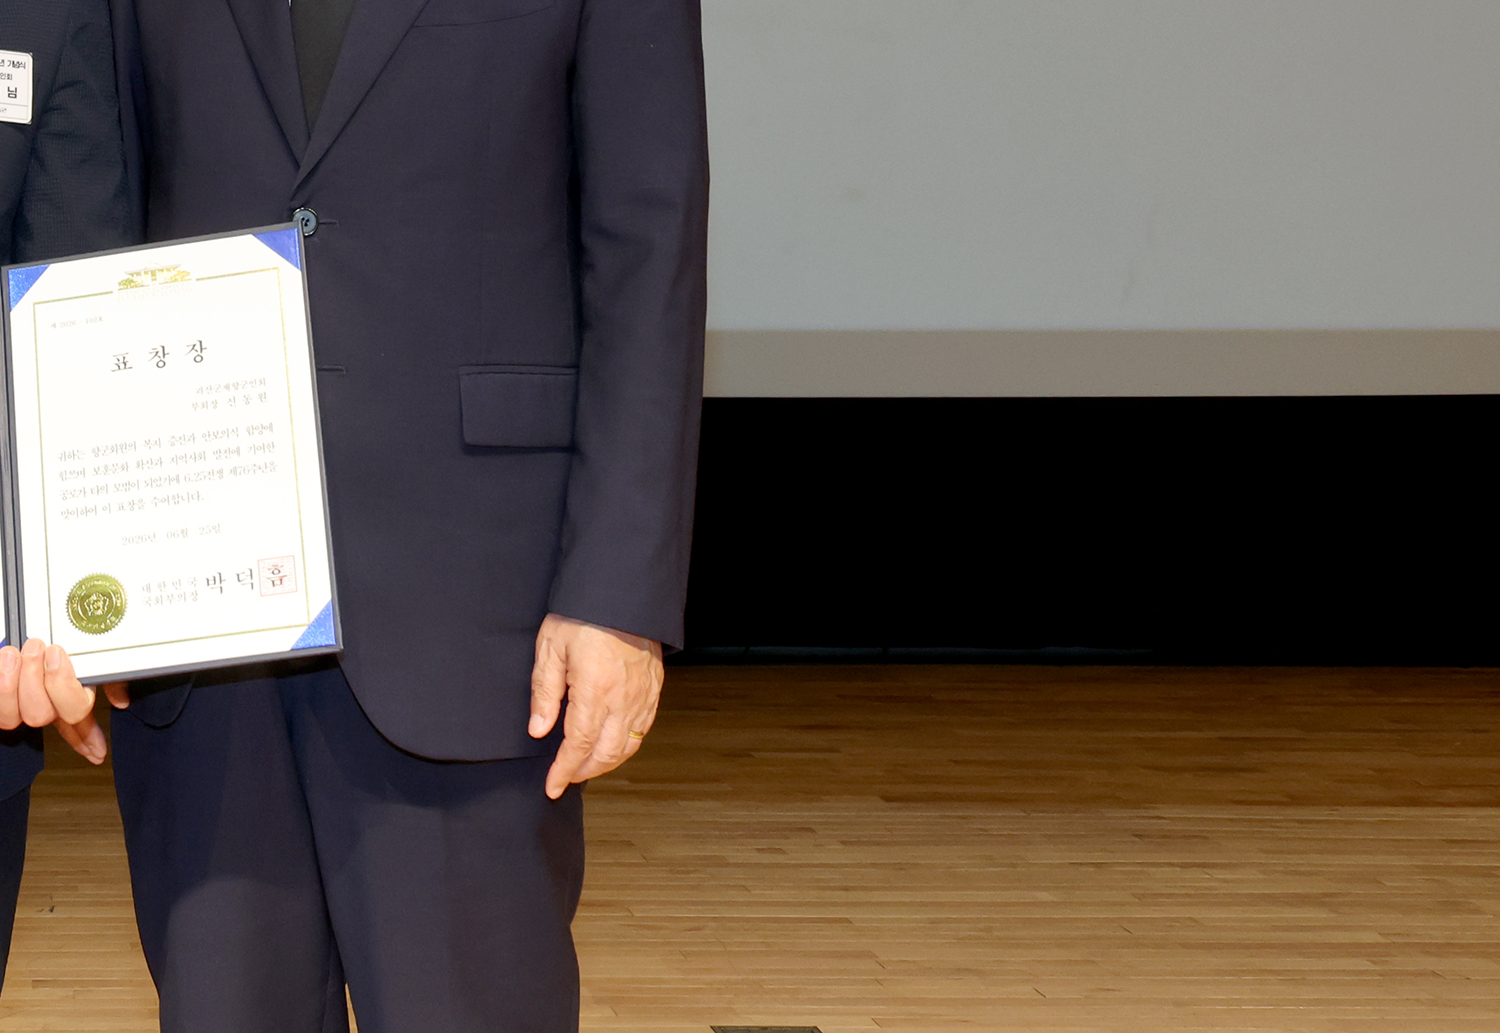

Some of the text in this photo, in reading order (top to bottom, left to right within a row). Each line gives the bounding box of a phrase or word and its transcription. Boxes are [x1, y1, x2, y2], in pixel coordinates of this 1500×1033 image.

[57, 449, 86, 462] 귀하는
[168, 432, 196, 447] 증진과
[202, 426, 239, 442] 안보의식
[245, 422, 273, 437] 함양에
[92, 461, 130, 476] 보훈문화
[169, 450, 206, 466] 지역사회
[213, 445, 241, 460] 발전에
[247, 441, 275, 455] 기여한
[59, 486, 87, 501] 공로가
[90, 483, 108, 496] 타의
[113, 479, 139, 492] 모범이
[102, 502, 111, 514] 이
[122, 523, 222, 546] 2026년 06월 25일
